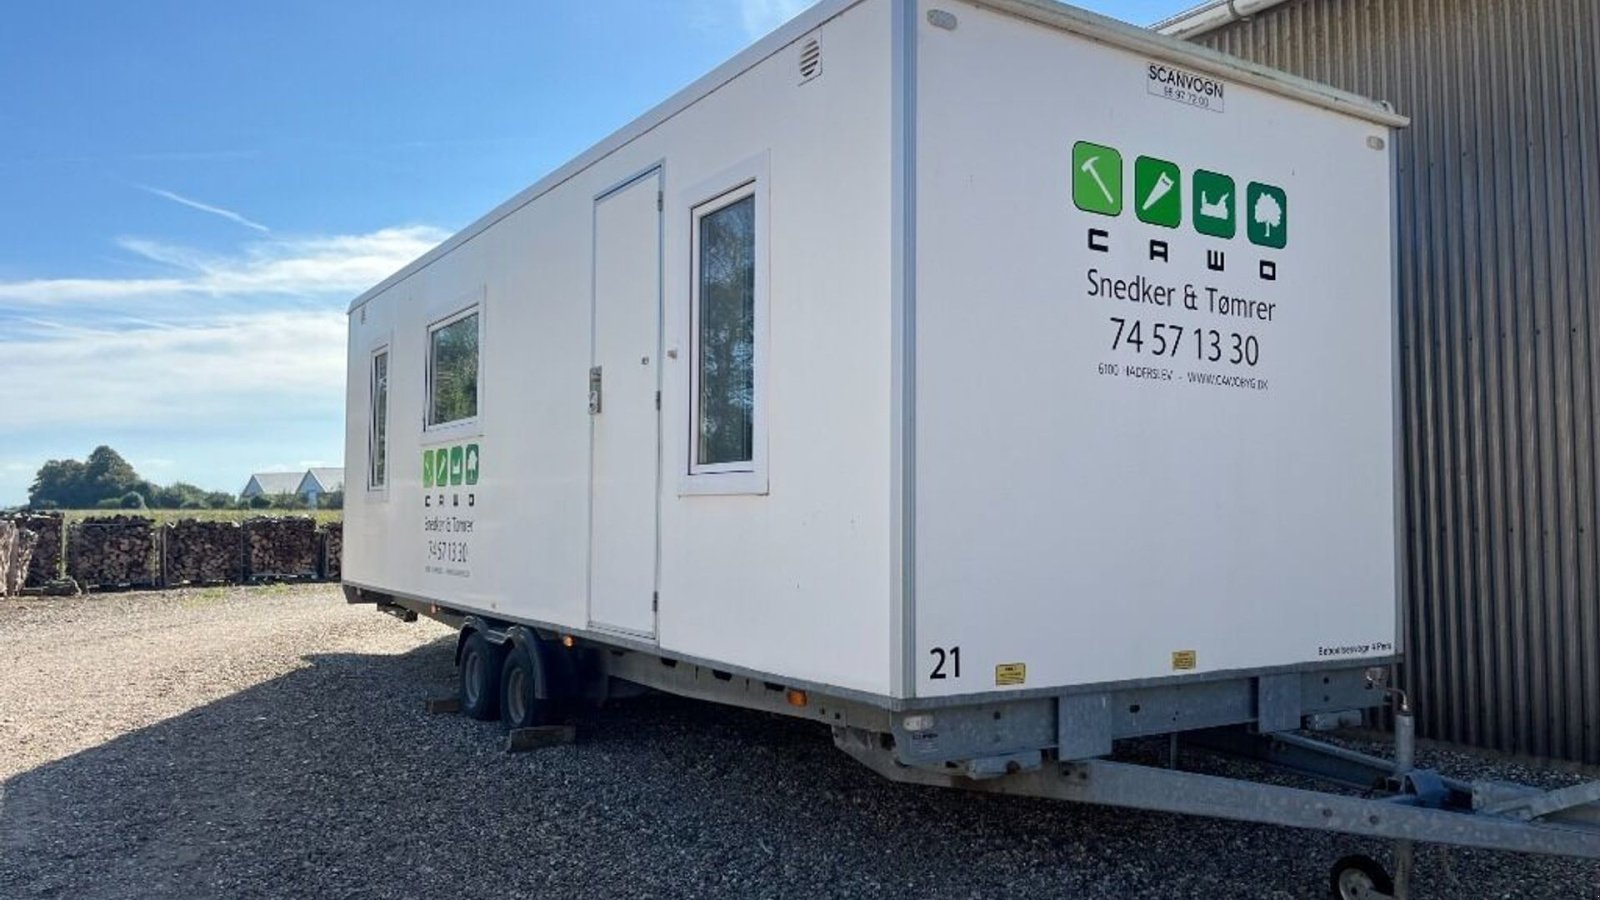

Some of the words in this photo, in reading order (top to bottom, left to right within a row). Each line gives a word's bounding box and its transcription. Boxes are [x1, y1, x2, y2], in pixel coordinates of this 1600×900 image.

[1148, 65, 1224, 98] SCANVOGN
[1087, 268, 1175, 307] Snedker
[1184, 284, 1199, 311] &
[1205, 287, 1276, 321] Tømrer
[1110, 317, 1143, 353] 74
[1152, 323, 1184, 357] 57
[1193, 328, 1222, 362] 13
[1229, 333, 1259, 366] 30
[1098, 362, 1119, 376] 6100
[437, 541, 447, 561] 57
[448, 541, 457, 562] 13
[930, 646, 960, 679] 21
